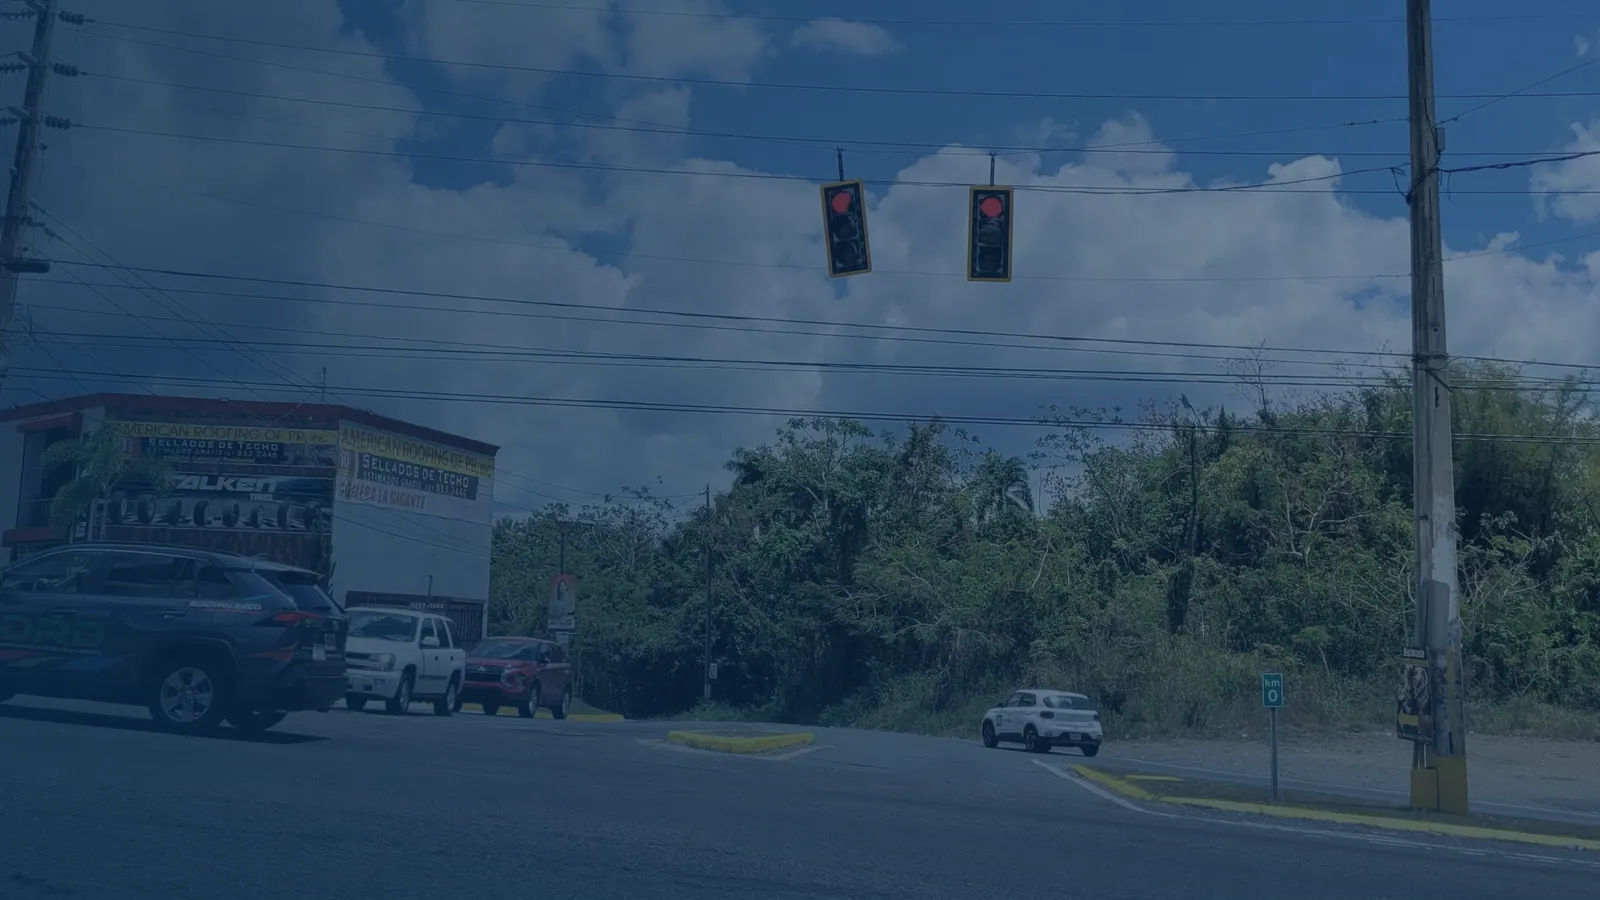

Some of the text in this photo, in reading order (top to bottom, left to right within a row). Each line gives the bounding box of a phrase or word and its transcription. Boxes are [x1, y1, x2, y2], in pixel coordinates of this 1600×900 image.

[194, 426, 258, 440] ROOFING
[265, 430, 283, 441] OF
[311, 435, 328, 443] INC
[148, 437, 278, 451] SELLADOS DE TECHO
[342, 427, 399, 456] AMERICAN
[403, 440, 448, 466] ROOFING
[451, 452, 462, 468] OF
[362, 454, 420, 477] SELLADOS
[422, 469, 435, 481] DE
[437, 469, 469, 488] TECHO
[363, 470, 399, 485] ESTIMADOS
[249, 492, 273, 501] TIRES
[390, 490, 426, 510] GIGANTE
[1264, 678, 1281, 688] km
[1268, 689, 1278, 702] 0
